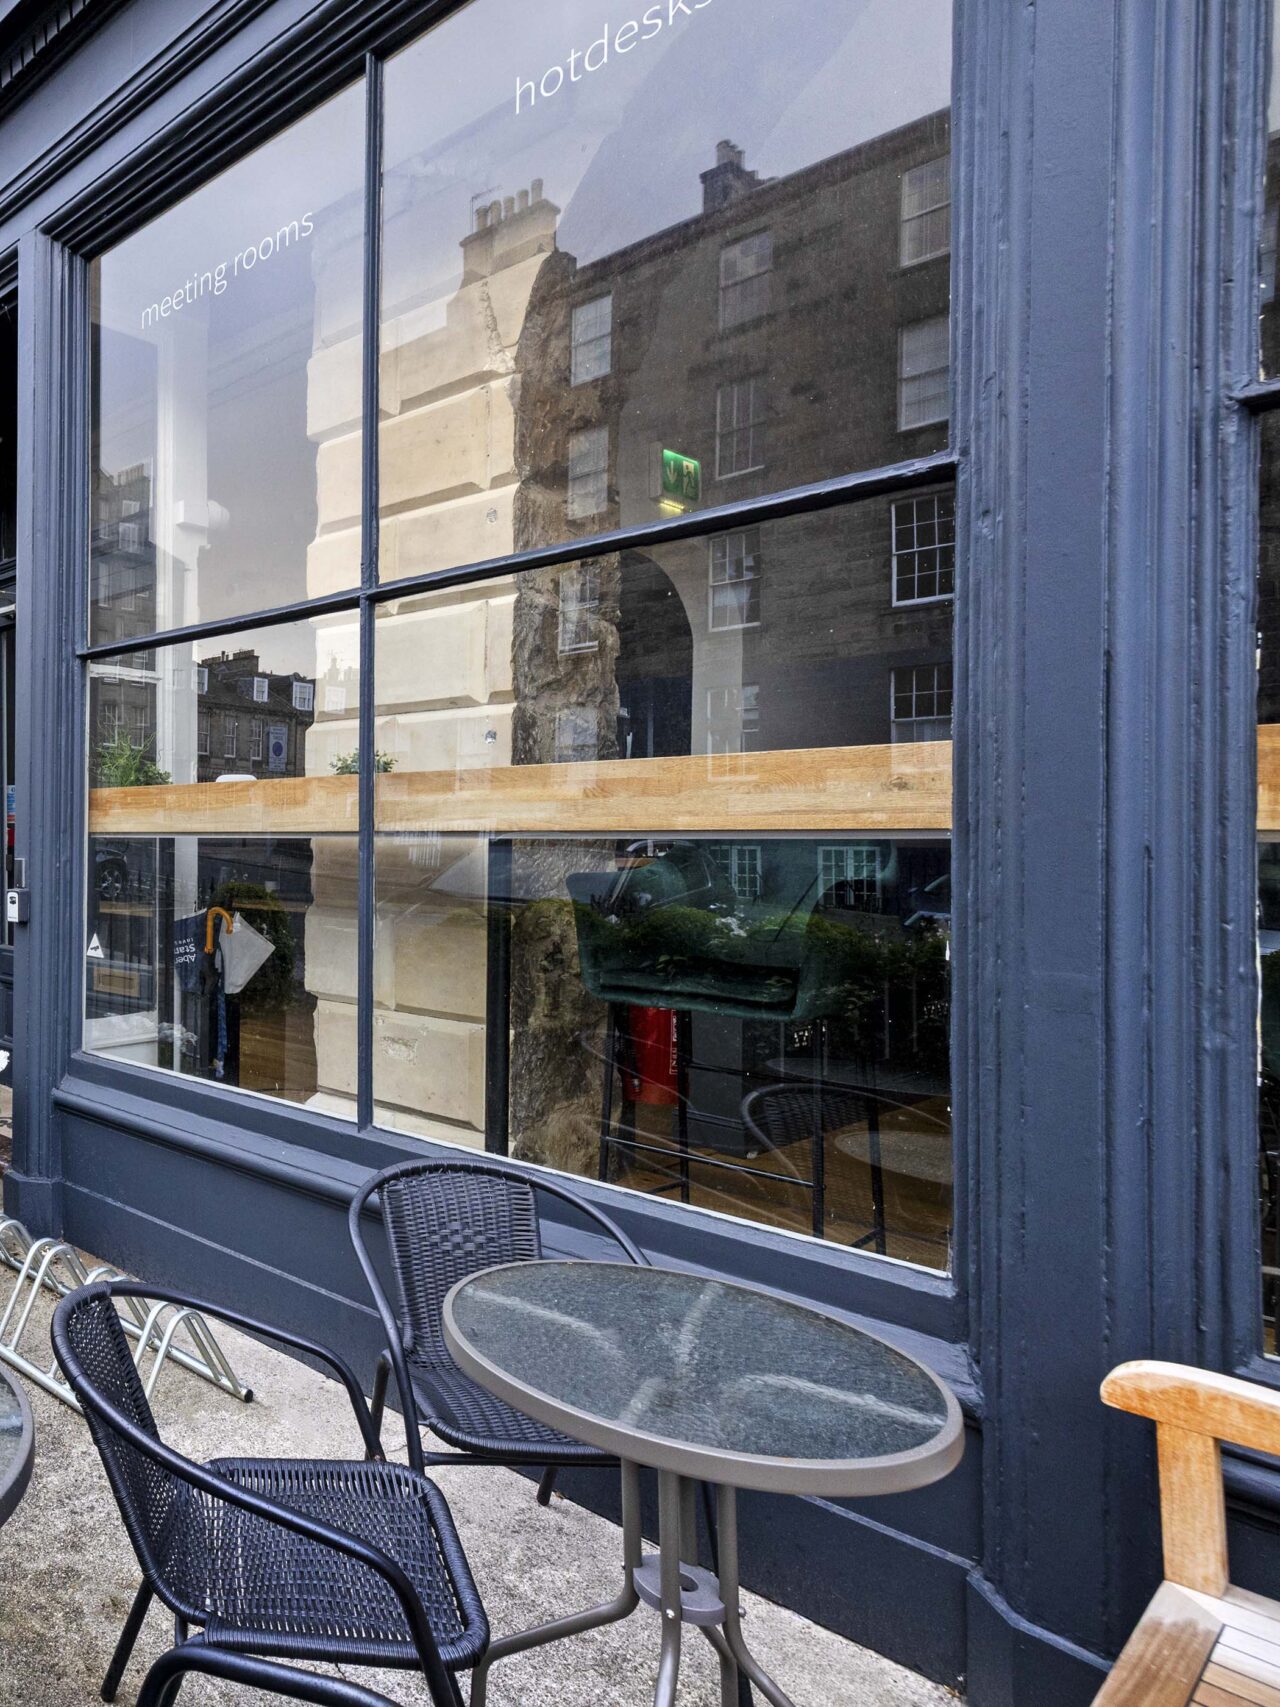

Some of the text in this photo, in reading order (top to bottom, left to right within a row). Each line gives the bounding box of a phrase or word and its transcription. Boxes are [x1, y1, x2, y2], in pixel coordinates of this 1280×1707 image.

[515, 0, 713, 115] hotdesk
[141, 211, 314, 330] meeting rooms
